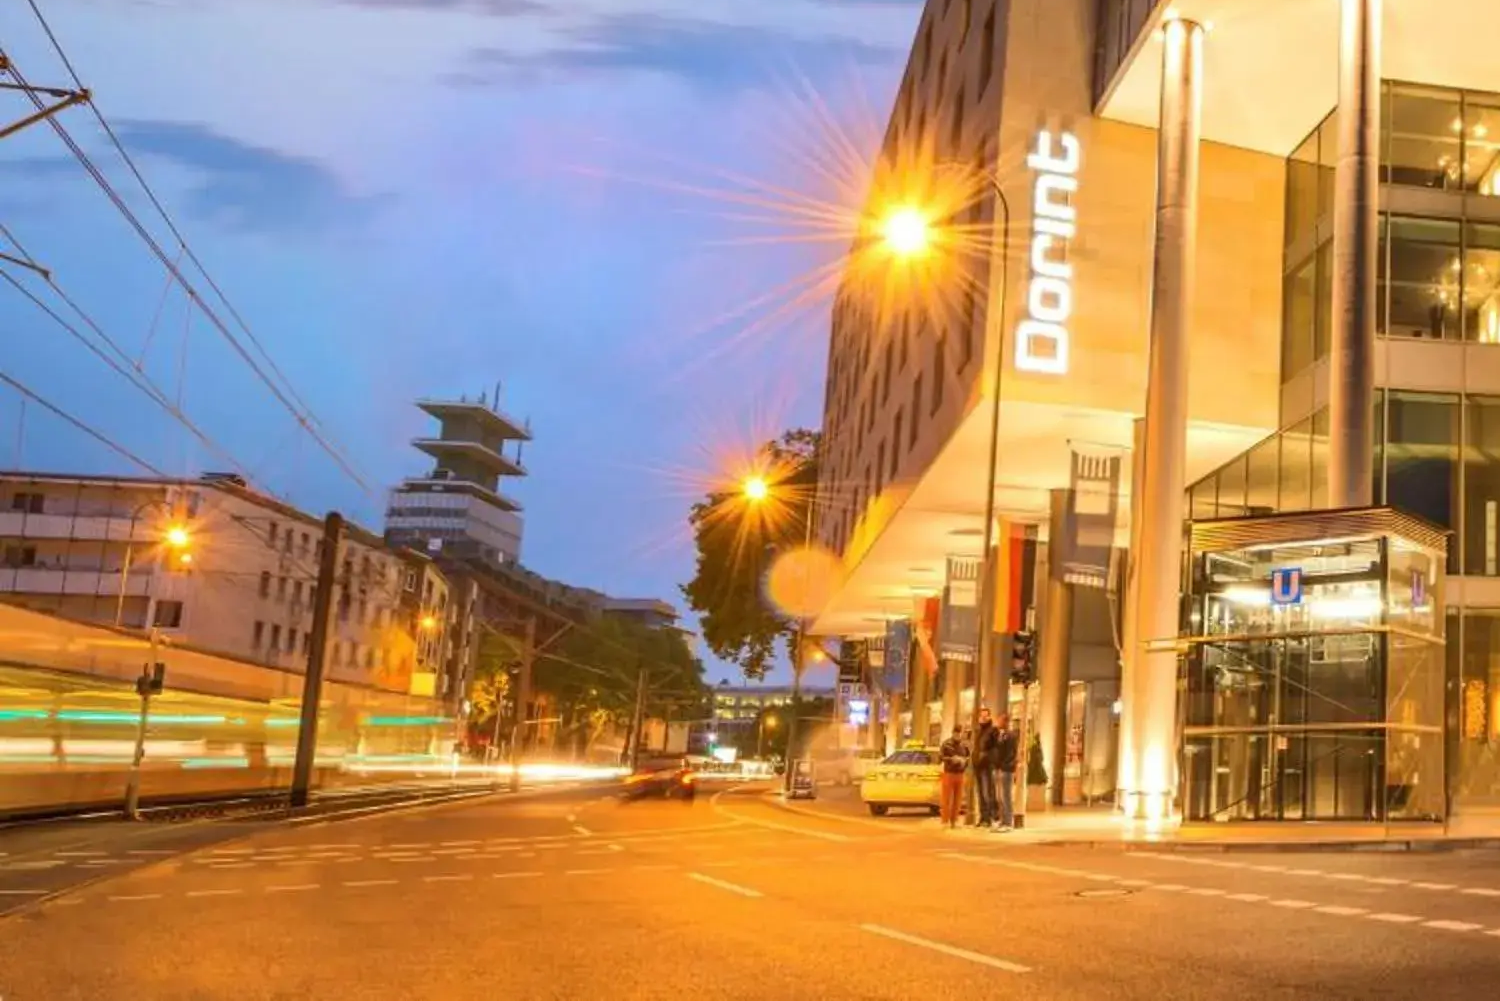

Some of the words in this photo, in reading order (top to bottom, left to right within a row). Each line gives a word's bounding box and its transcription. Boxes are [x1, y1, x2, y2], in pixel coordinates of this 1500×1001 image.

[1015, 130, 1080, 374] Dorint
[1273, 571, 1300, 603] U
[1411, 571, 1425, 605] U
